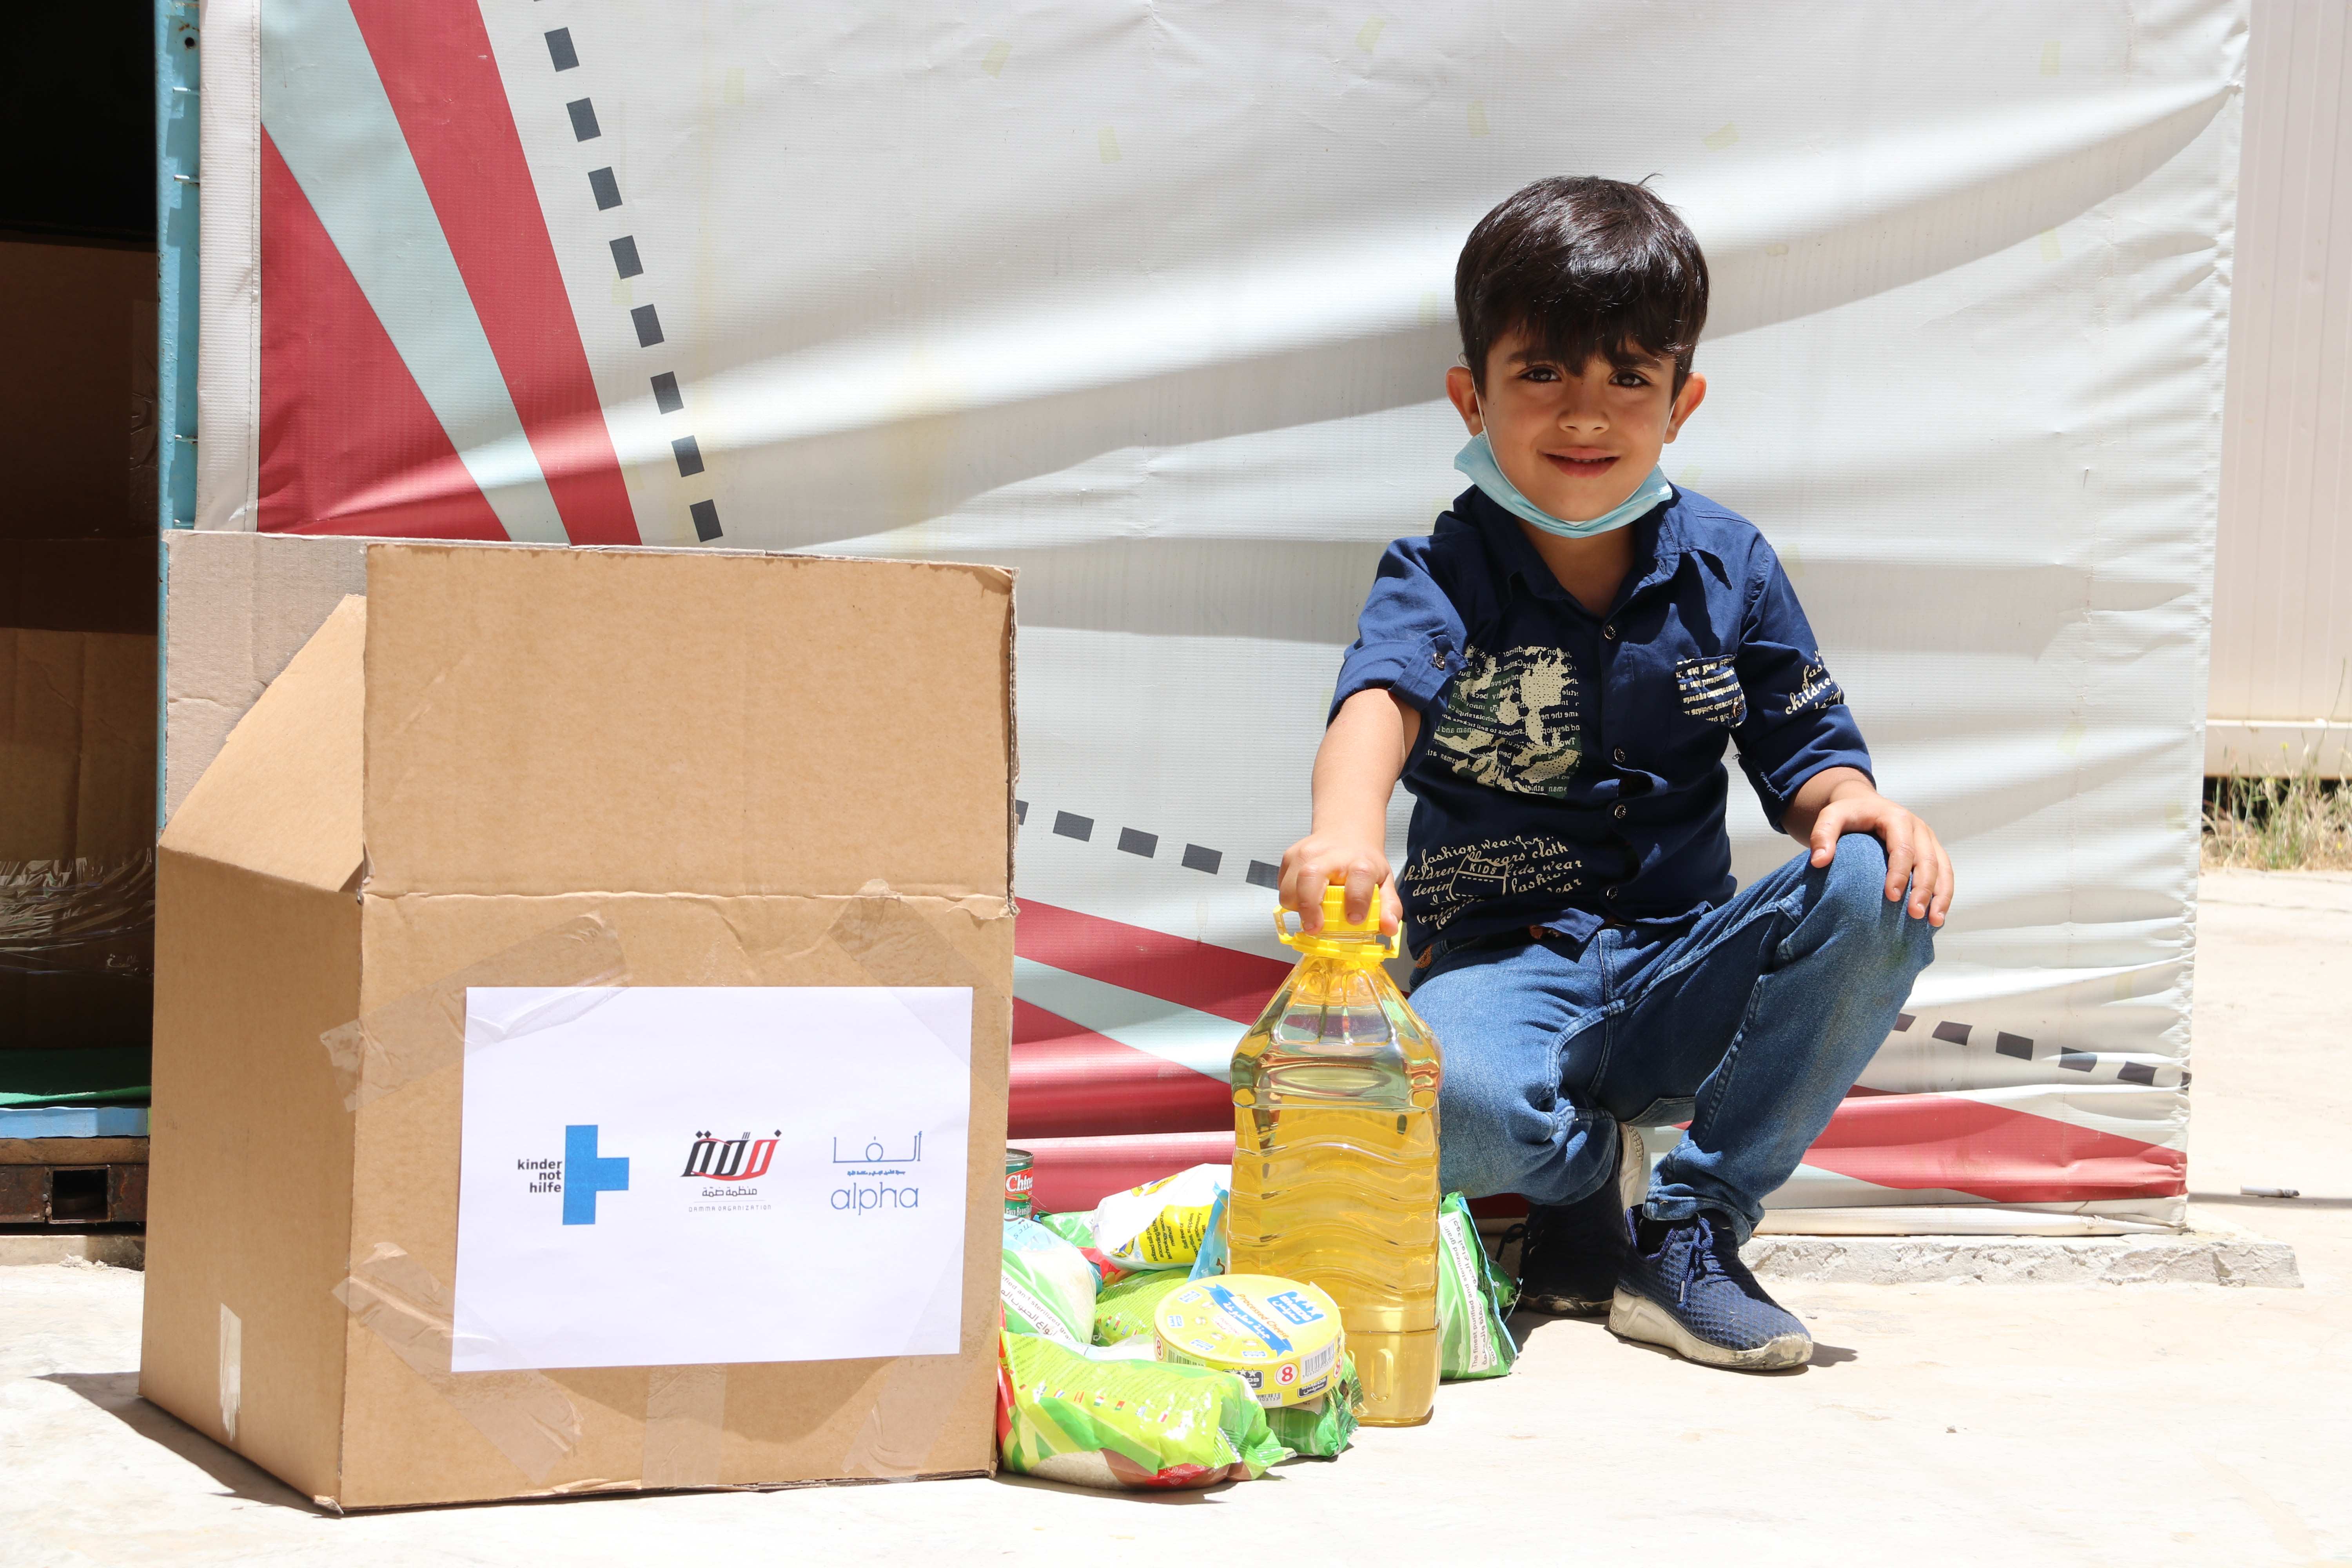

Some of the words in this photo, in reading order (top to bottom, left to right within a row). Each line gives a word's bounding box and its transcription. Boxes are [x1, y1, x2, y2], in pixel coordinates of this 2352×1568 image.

[1421, 843, 1477, 869] fashion
[1405, 866, 1455, 882] hildren
[1469, 863, 1497, 875] KIDS
[1412, 882, 1451, 897] denim
[517, 1158, 563, 1170] kinder
[539, 1170, 562, 1180] not
[530, 1181, 562, 1193] hilfe
[726, 1185, 757, 1197] منظمة
[831, 1181, 919, 1216] alpha
[1167, 1226, 1176, 1246] method
[1030, 1301, 1061, 1326] sterilized
[1236, 1294, 1270, 1320] Processed
[1266, 1320, 1289, 1338] Cheese
[1469, 1300, 1478, 1330] purified
[1281, 1366, 1293, 1382] 8
